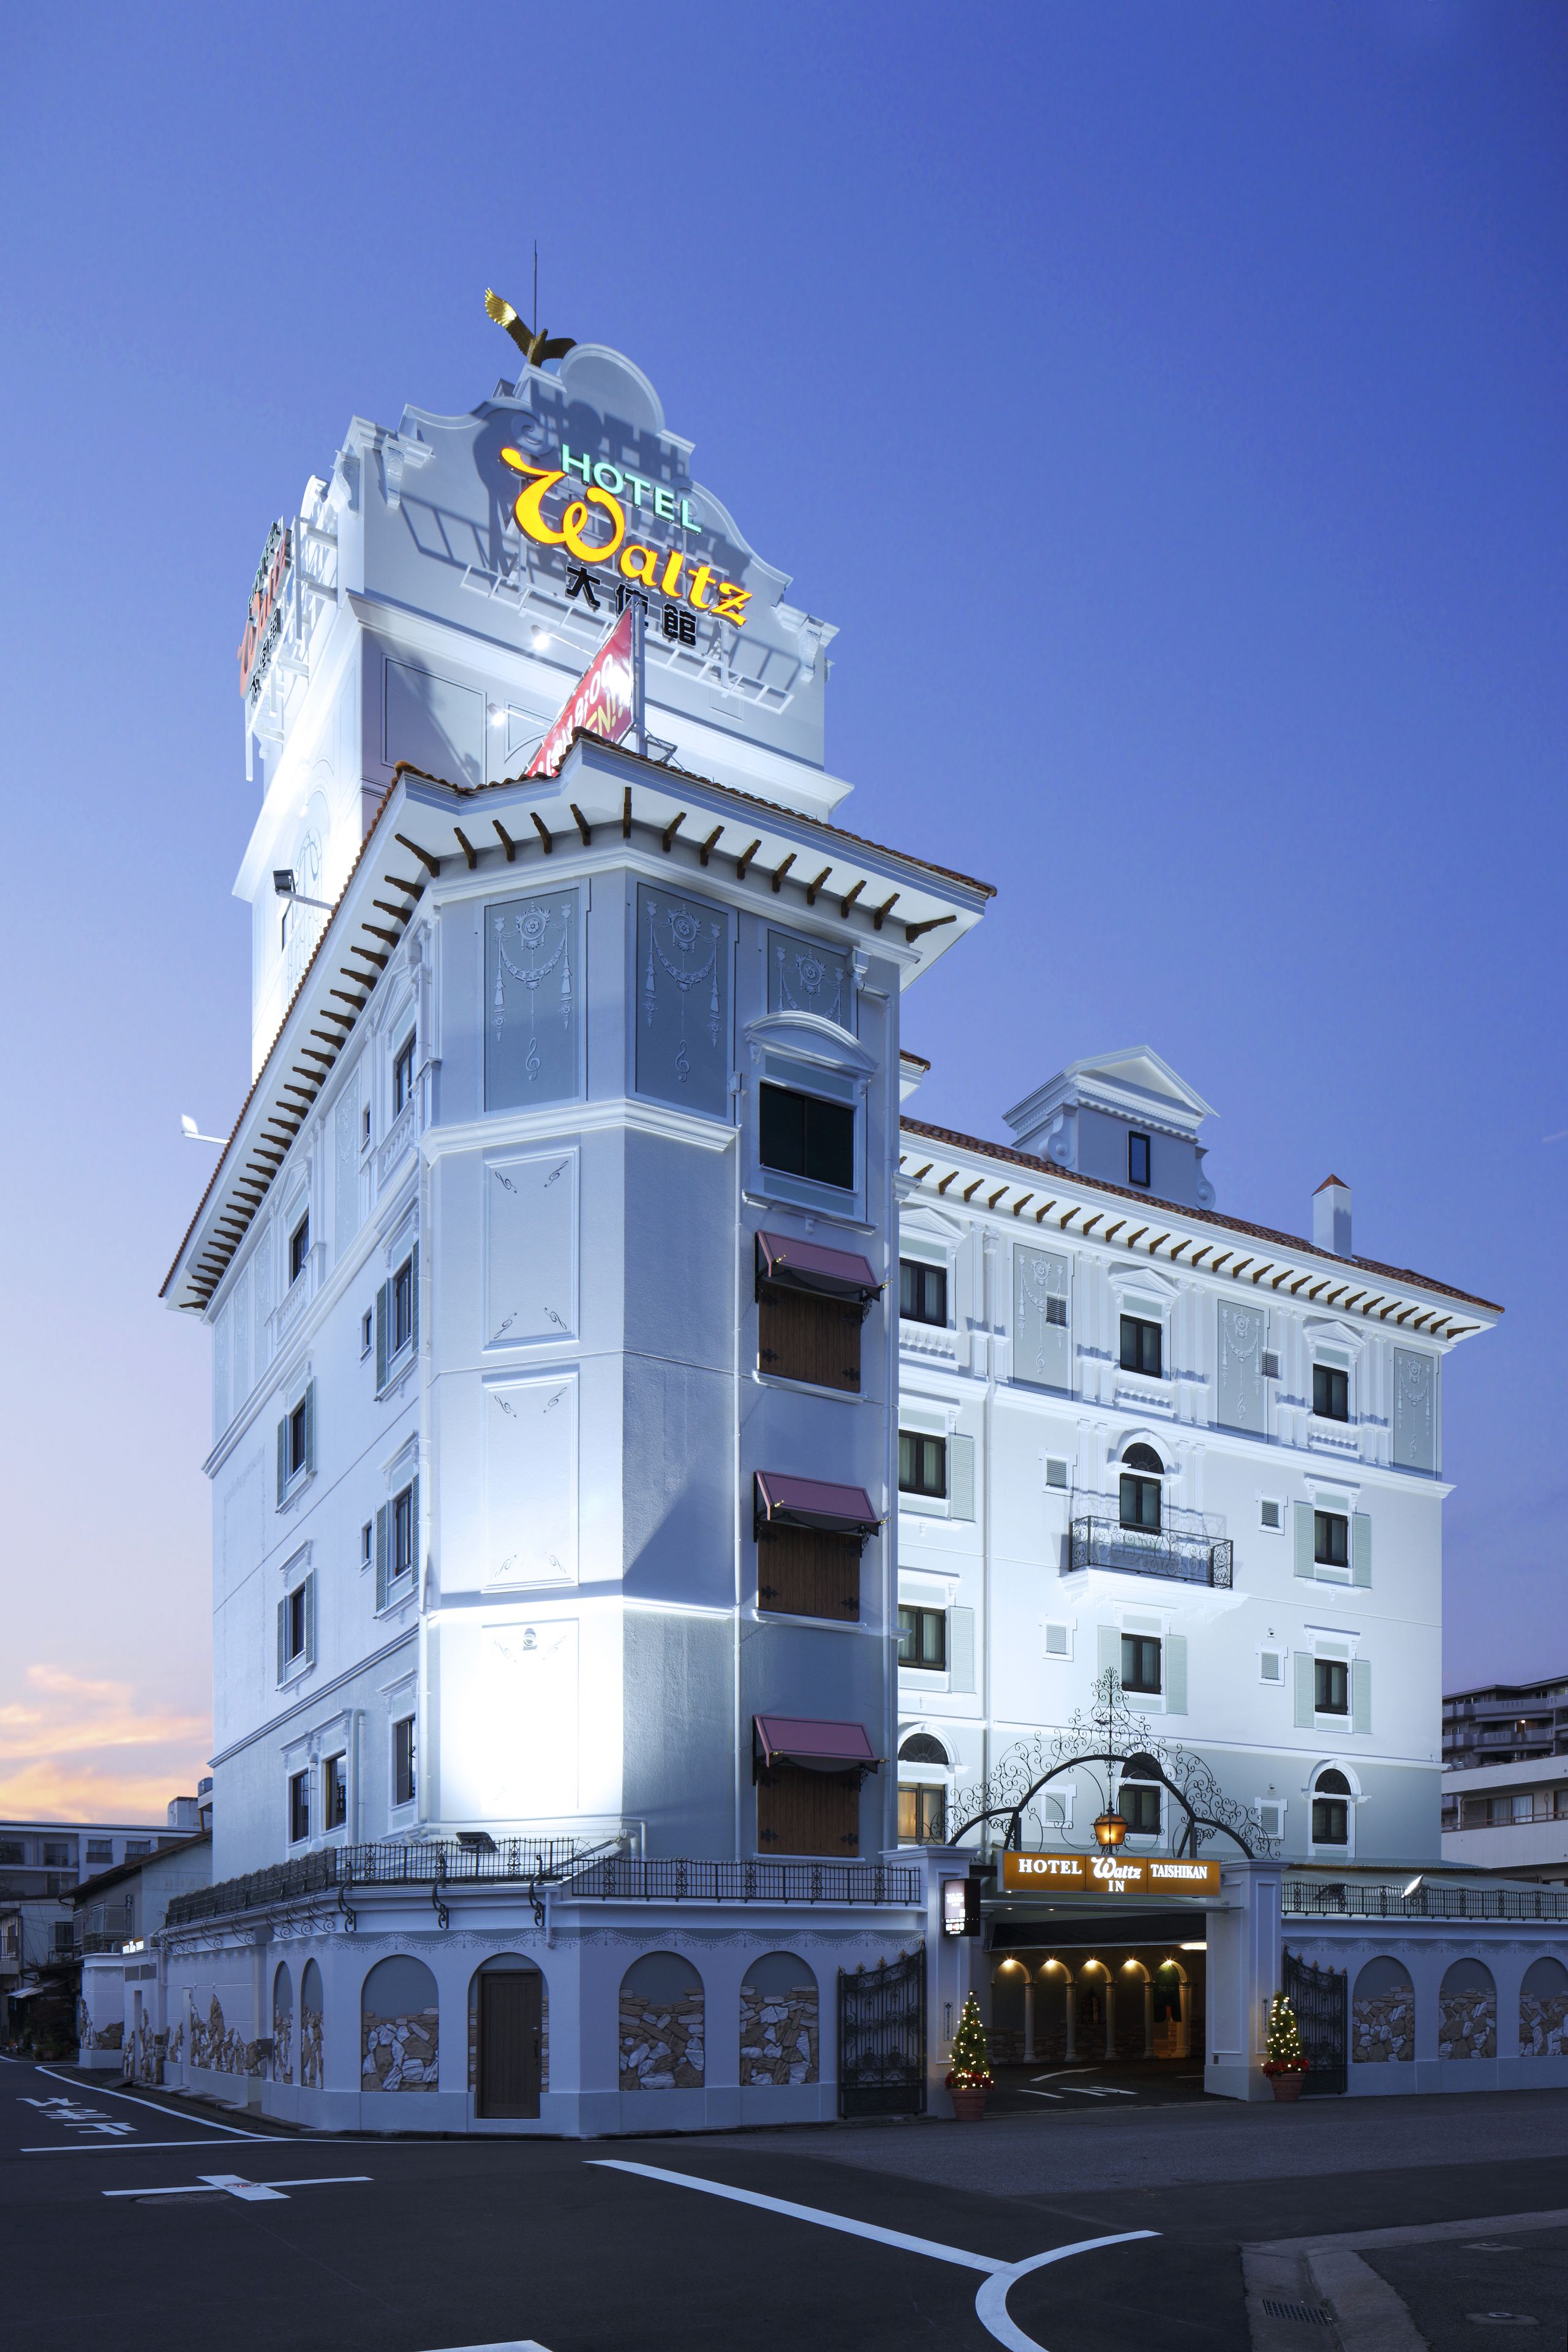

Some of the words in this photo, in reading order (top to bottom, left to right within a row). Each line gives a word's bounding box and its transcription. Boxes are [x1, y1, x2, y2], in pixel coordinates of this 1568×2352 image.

[562, 443, 701, 533] HOTEL
[499, 447, 753, 627] Waltz
[1018, 1858, 1082, 1875] HOTEL
[1091, 1856, 1142, 1879] Waltz
[1150, 1864, 1208, 1880] TAISHIKAN
[1108, 1880, 1125, 1893] IN
